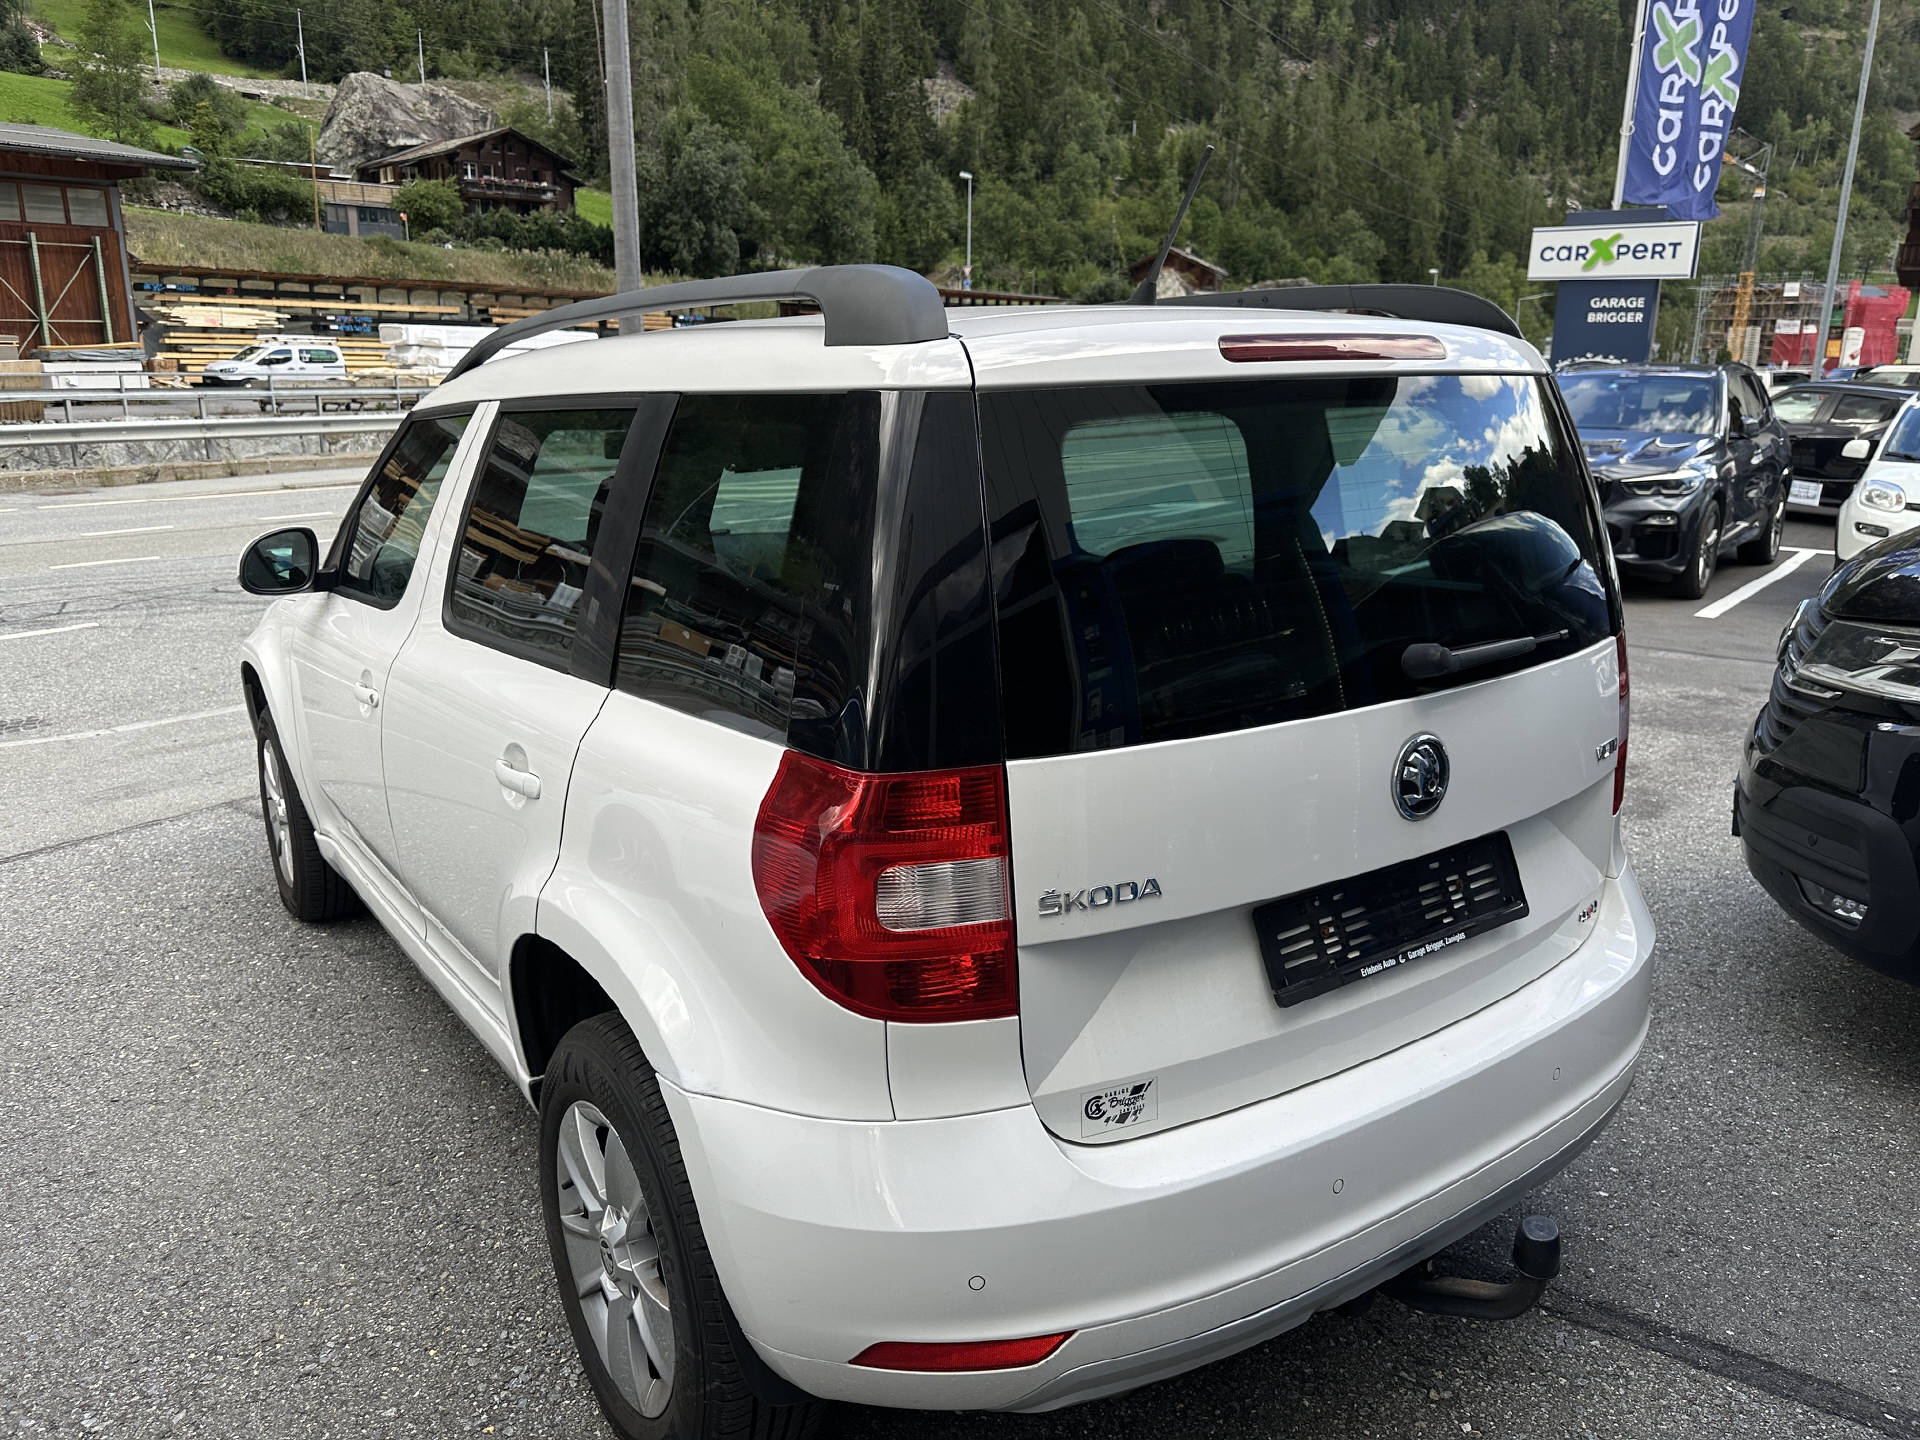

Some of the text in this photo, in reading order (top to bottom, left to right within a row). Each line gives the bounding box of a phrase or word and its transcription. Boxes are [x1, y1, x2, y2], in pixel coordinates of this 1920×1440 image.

[1590, 297, 1645, 309] GARAGE
[1586, 312, 1644, 323] BRIGGER
[1038, 878, 1162, 917] ŠKODA
[1360, 963, 1383, 977] Erlebnis
[1382, 958, 1396, 969] Auto
[1407, 947, 1426, 960] Garage
